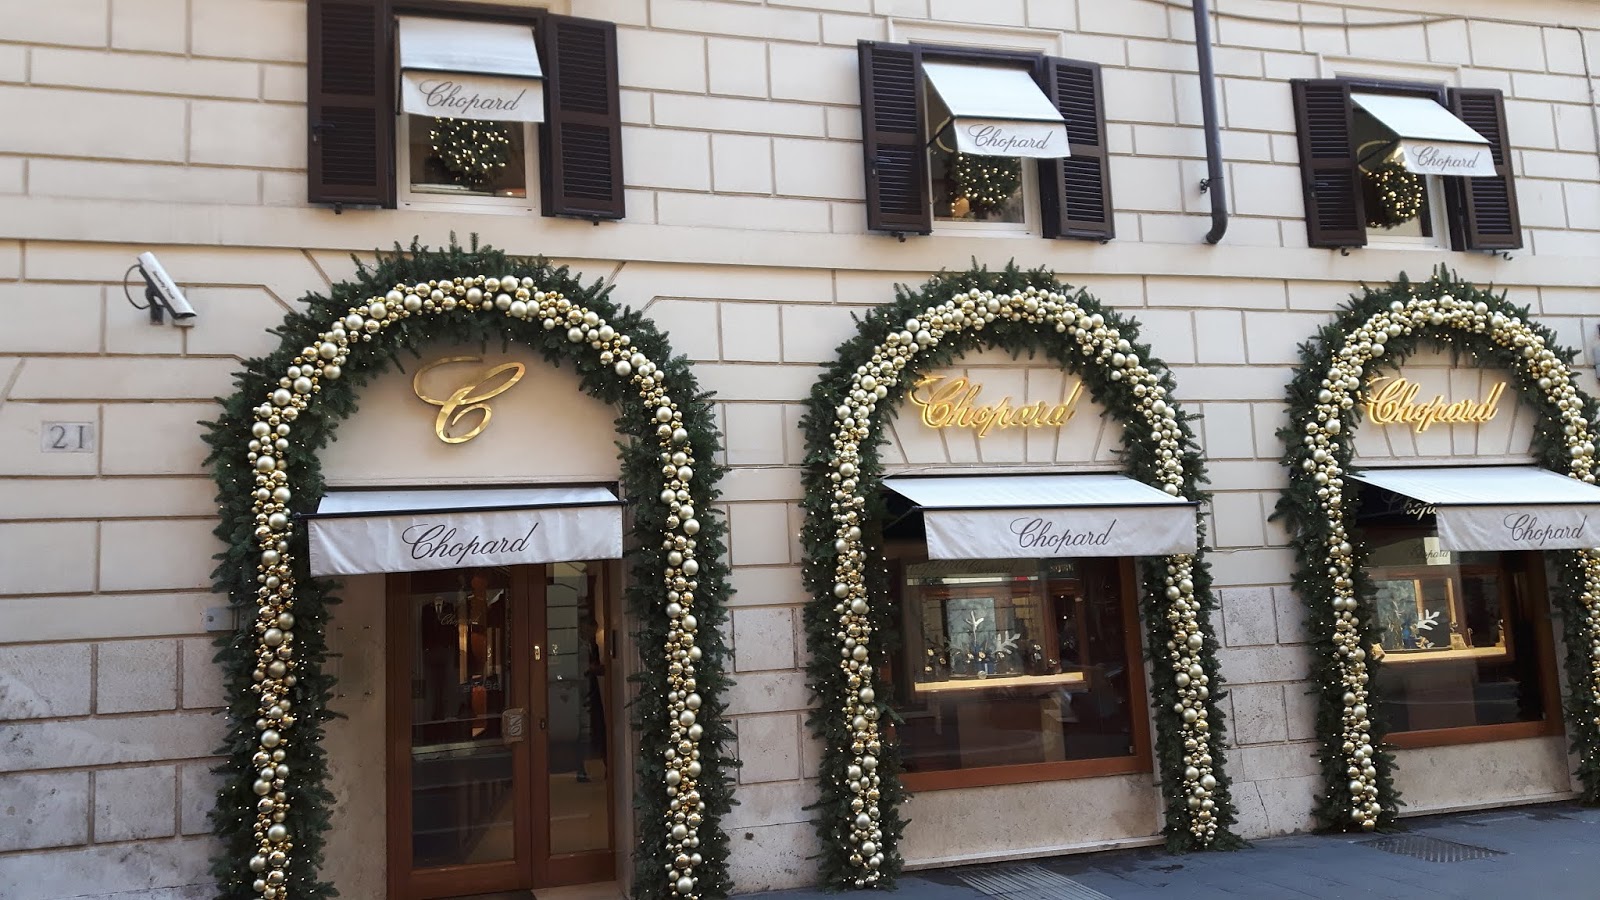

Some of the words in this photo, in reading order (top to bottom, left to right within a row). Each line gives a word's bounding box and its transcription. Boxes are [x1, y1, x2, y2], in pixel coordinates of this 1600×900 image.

[419, 80, 527, 114] Chopard
[967, 123, 1054, 153] Chopard
[1412, 144, 1480, 171] Chopard
[413, 356, 526, 444] C
[909, 375, 1085, 438] Chopard
[1356, 376, 1507, 434] Chopard
[50, 425, 86, 449] 21
[401, 522, 539, 565] Chopard
[1009, 517, 1117, 554] Chopard
[1503, 512, 1588, 546] Chopard
